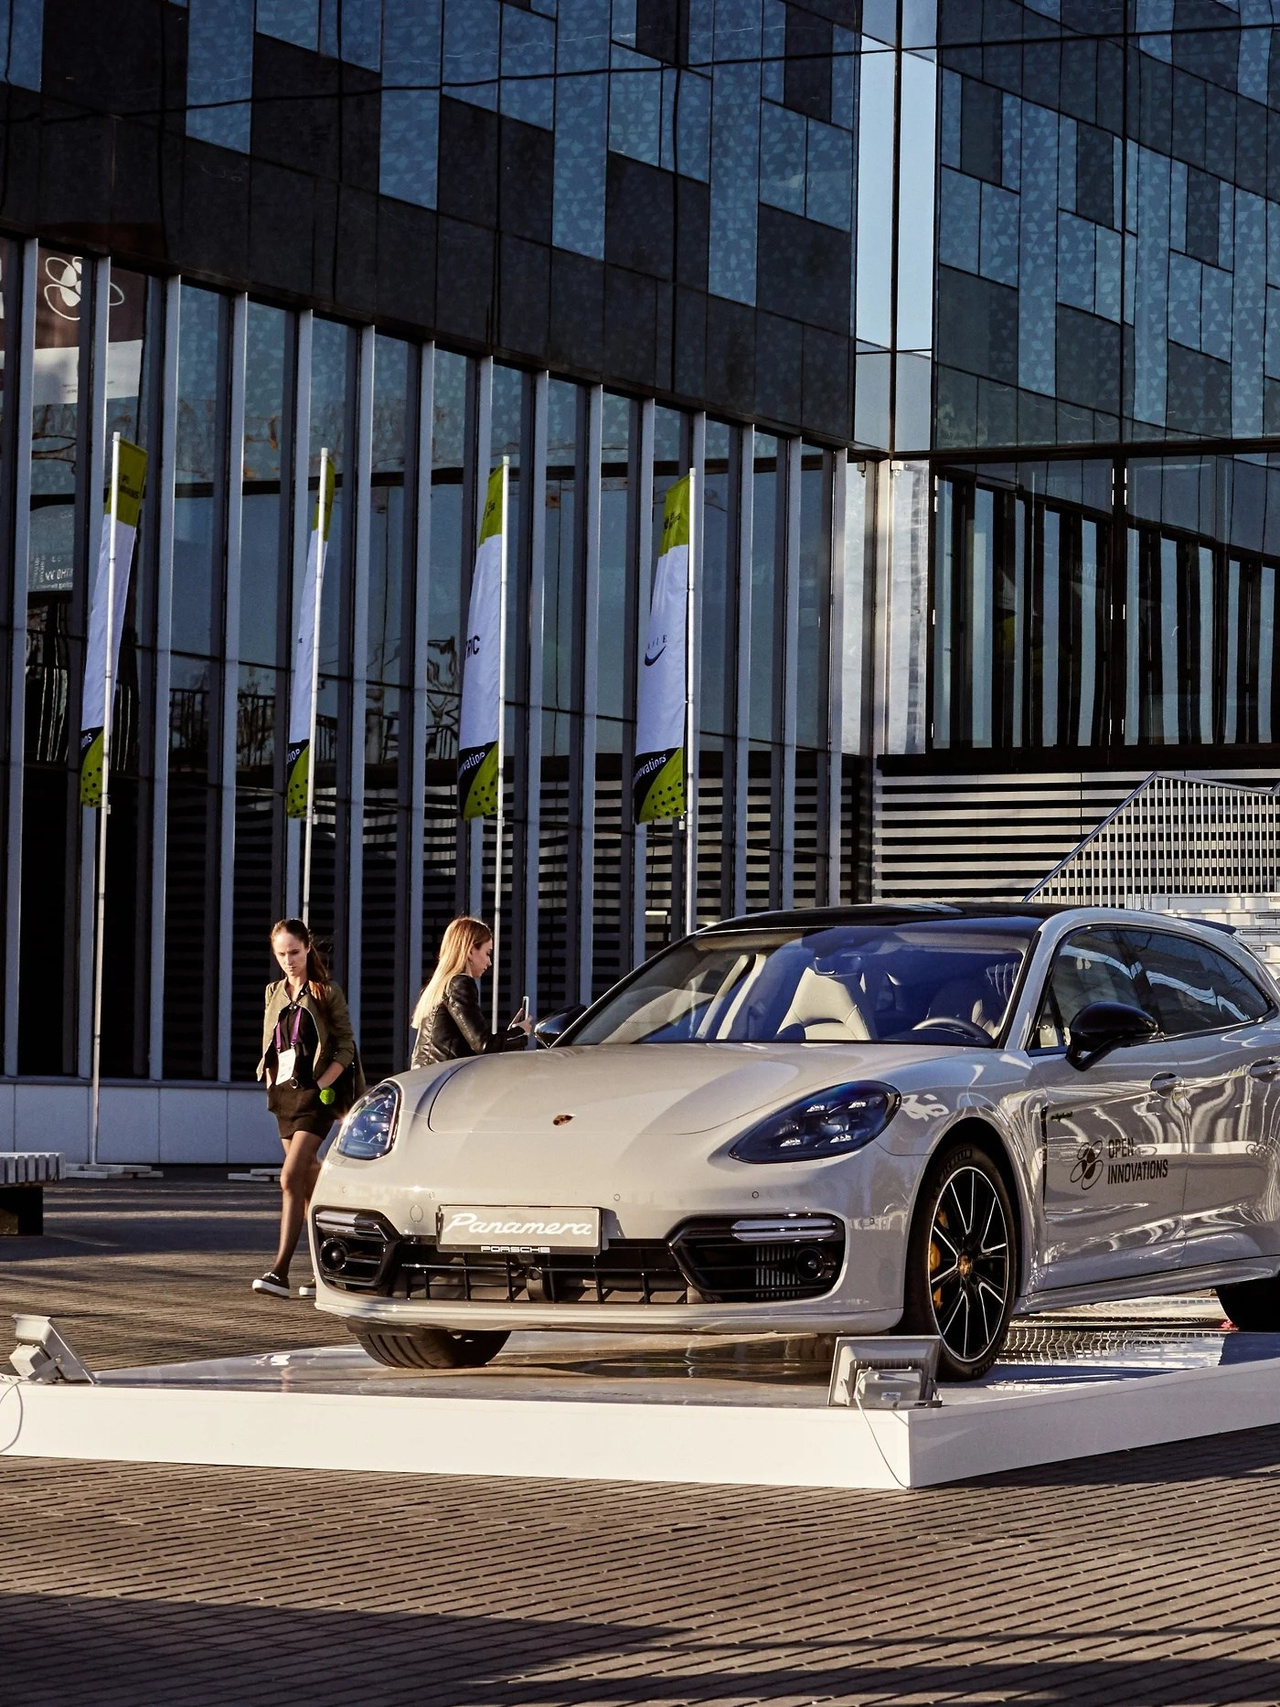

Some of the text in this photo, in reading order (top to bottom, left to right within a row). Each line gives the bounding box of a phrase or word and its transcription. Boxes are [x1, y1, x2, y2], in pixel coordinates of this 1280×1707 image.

[1108, 1137, 1134, 1159] OPEN
[1107, 1159, 1169, 1185] INNOVATIONS
[444, 1212, 593, 1235] Panamera
[480, 1245, 551, 1254] PORSCHE
